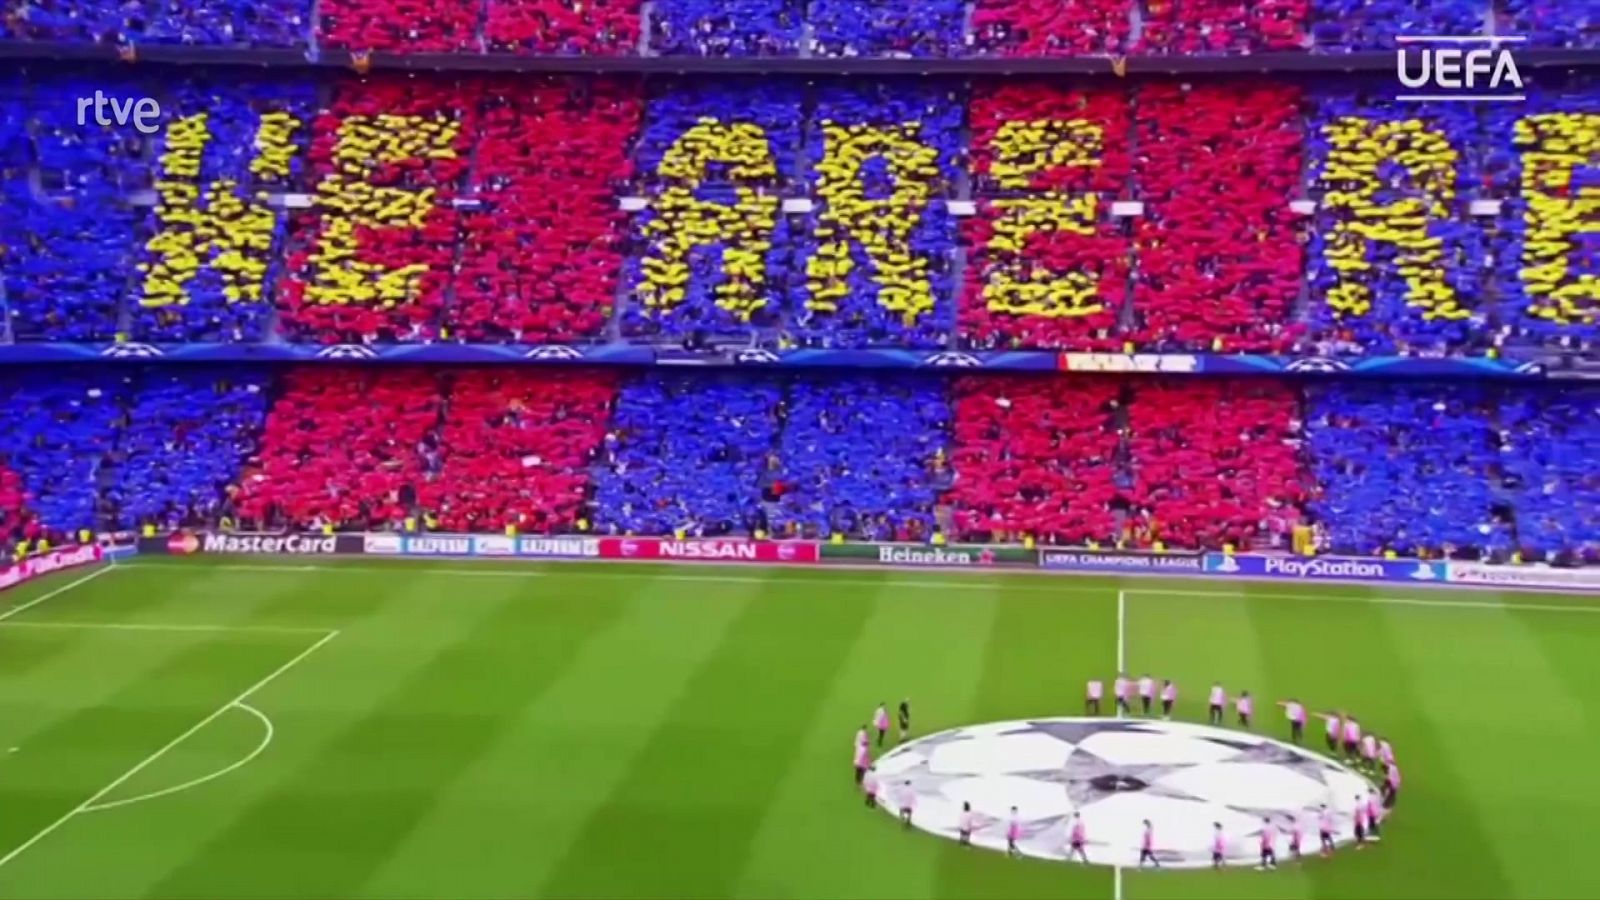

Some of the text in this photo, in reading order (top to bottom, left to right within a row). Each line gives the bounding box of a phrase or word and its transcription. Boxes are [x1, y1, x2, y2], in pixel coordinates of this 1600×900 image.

[636, 114, 1103, 322] ARE
[204, 533, 337, 554] MasterCard
[659, 541, 757, 559] NISSAN
[878, 545, 971, 564] Heineken
[1045, 554, 1200, 568] UEFA CHAMPIONS LEAGUE
[1264, 556, 1384, 577] PlayStation
